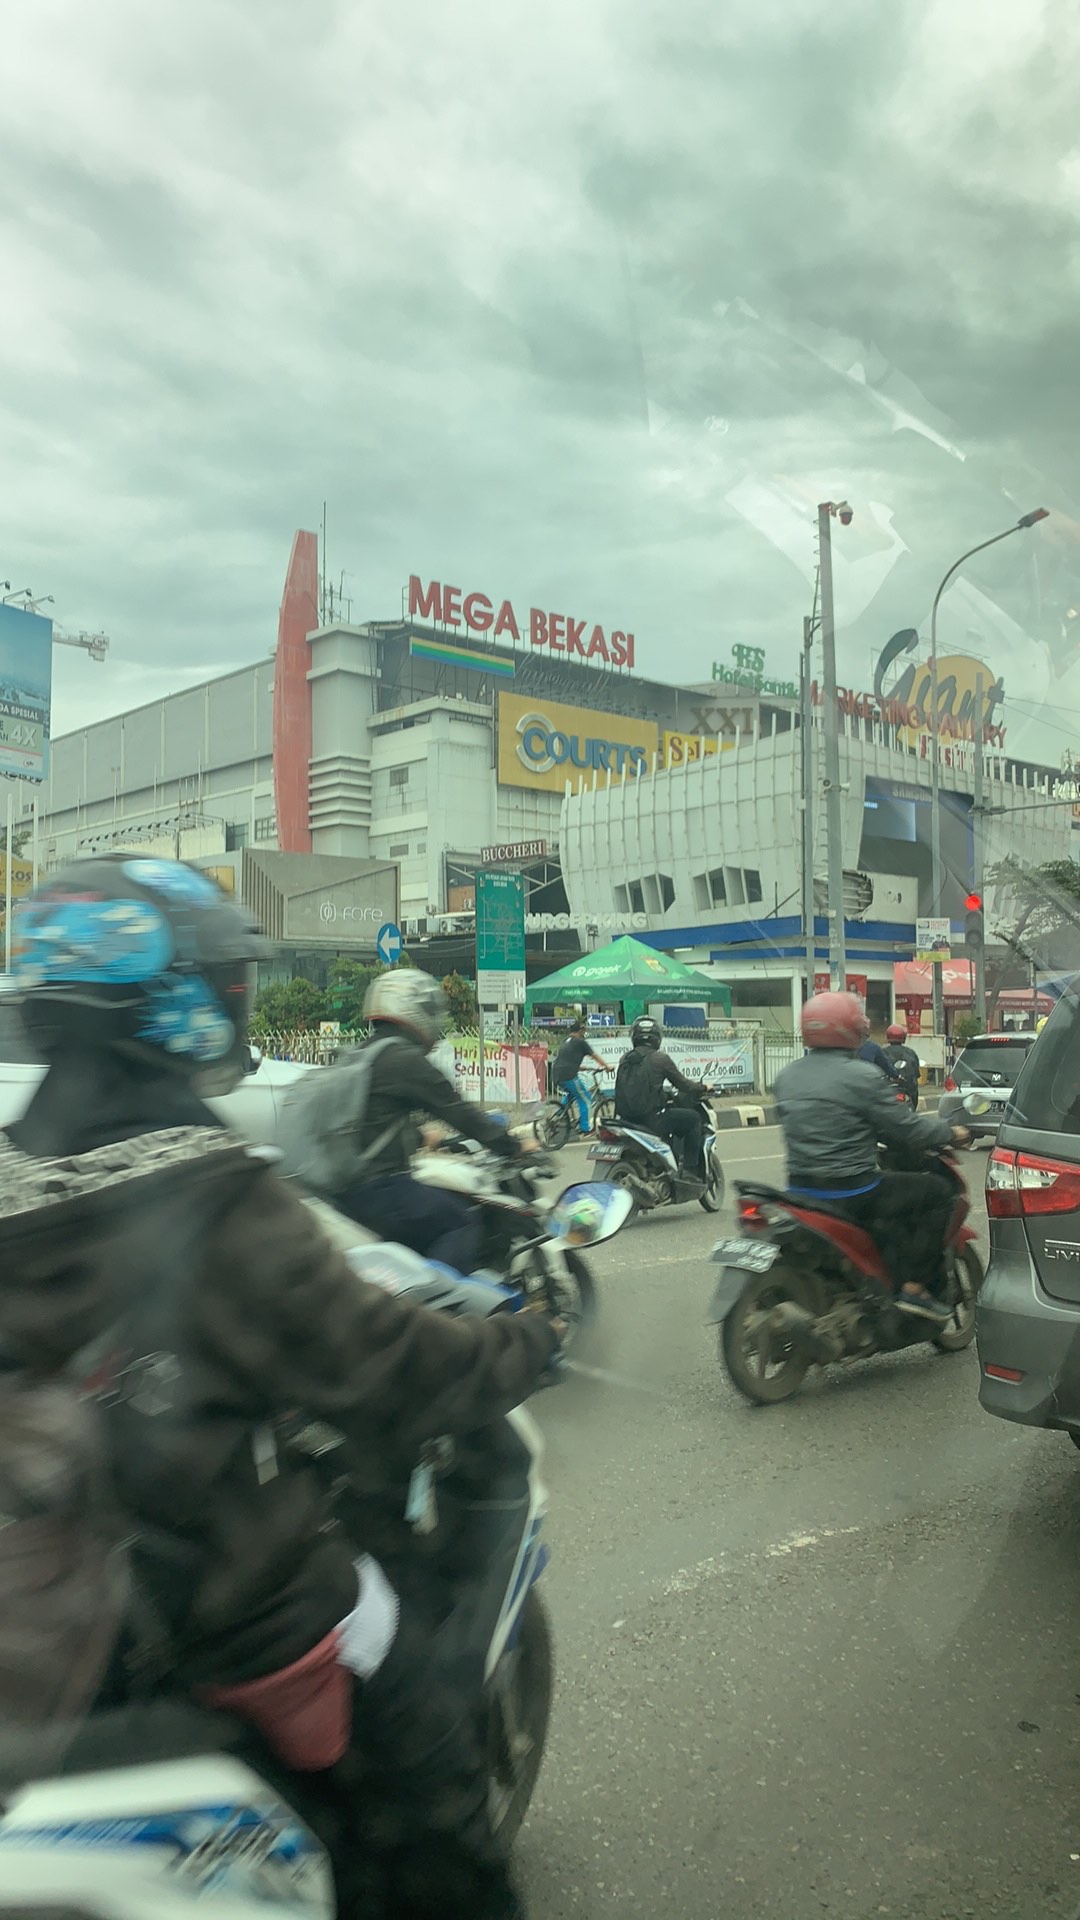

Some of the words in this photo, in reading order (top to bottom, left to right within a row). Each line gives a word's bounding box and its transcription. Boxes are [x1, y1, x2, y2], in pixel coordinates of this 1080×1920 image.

[408, 574, 520, 641] MEGA
[529, 607, 635, 669] BEKASI
[711, 661, 755, 692] Hotel
[10, 705, 39, 721] SPESIAL
[810, 679, 921, 730] RKETING
[688, 706, 754, 737] XXI
[10, 723, 37, 750] 4X
[522, 726, 648, 777] COURTS
[481, 842, 543, 863] BUCCHERI
[342, 906, 384, 922] fore
[524, 911, 597, 931] URGER
[454, 1045, 478, 1060] Hari
[482, 1047, 508, 1061] Aids
[682, 1067, 701, 1077] 10.00
[728, 1065, 744, 1076] WIB
